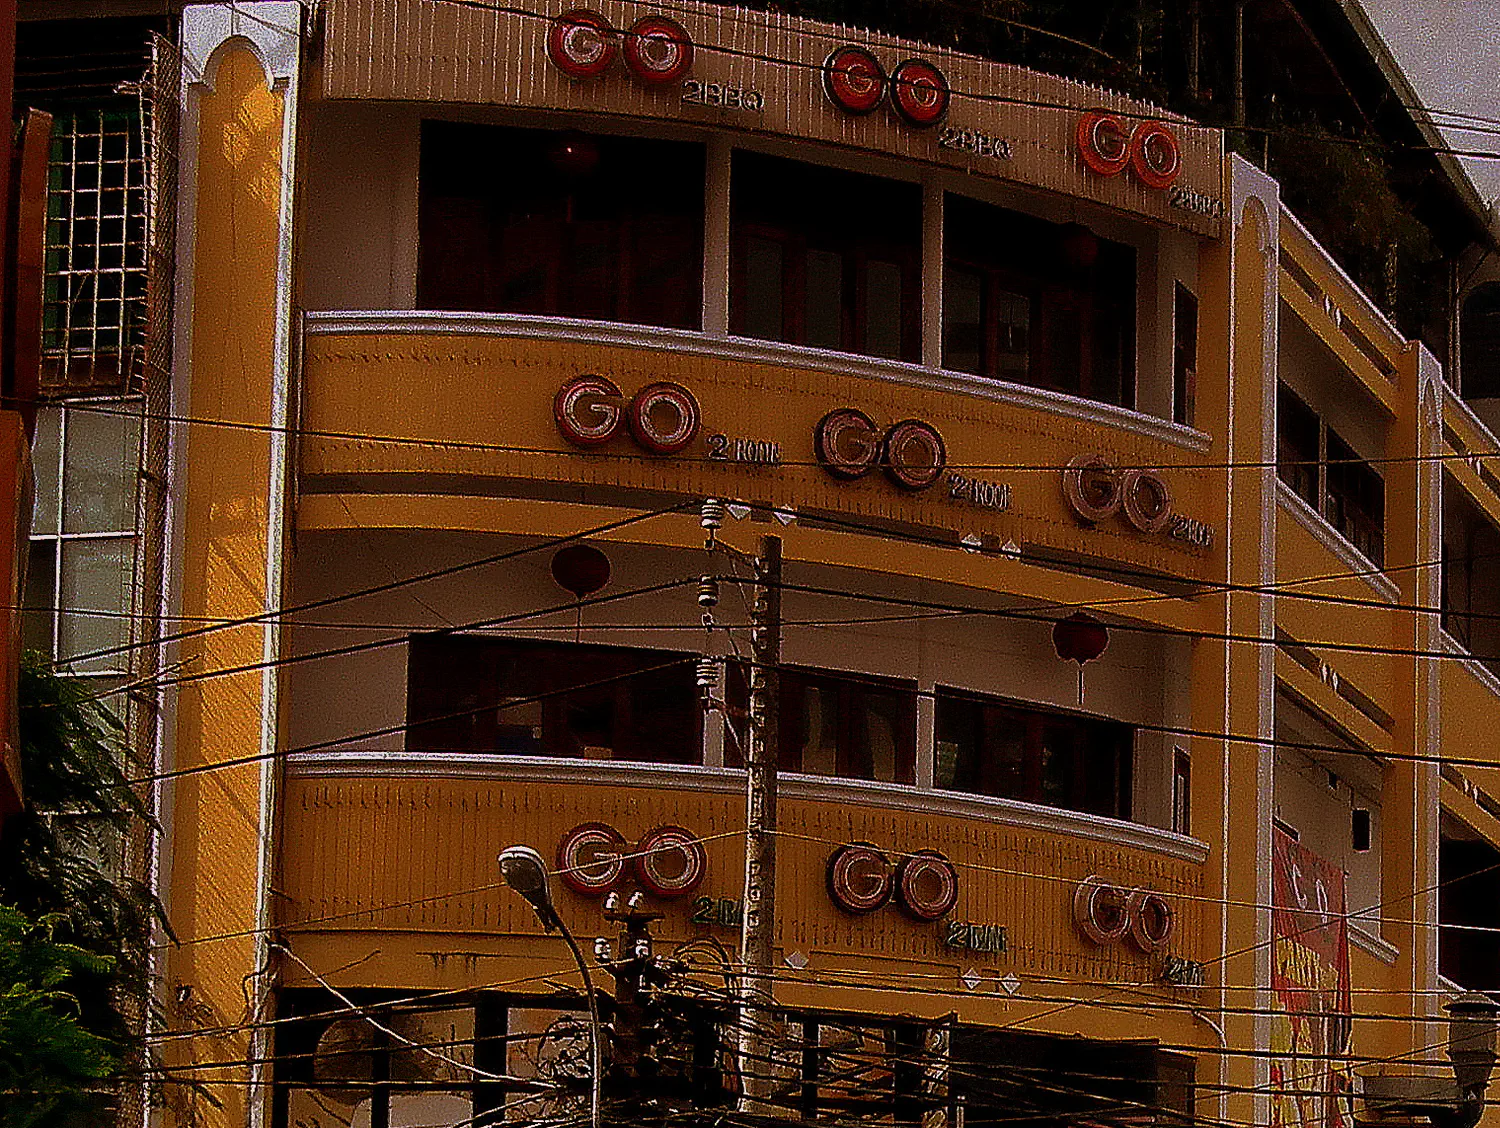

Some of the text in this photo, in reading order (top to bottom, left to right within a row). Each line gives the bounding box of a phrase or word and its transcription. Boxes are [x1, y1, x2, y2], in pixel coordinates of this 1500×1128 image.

[546, 8, 695, 85] GO
[822, 44, 951, 127] GO
[1076, 108, 1181, 189] GO
[553, 374, 702, 453] GO
[813, 407, 947, 491] GO
[1062, 453, 1174, 536] GO
[557, 821, 708, 899] GO
[825, 840, 960, 924] GO
[1072, 874, 1176, 954] GO
